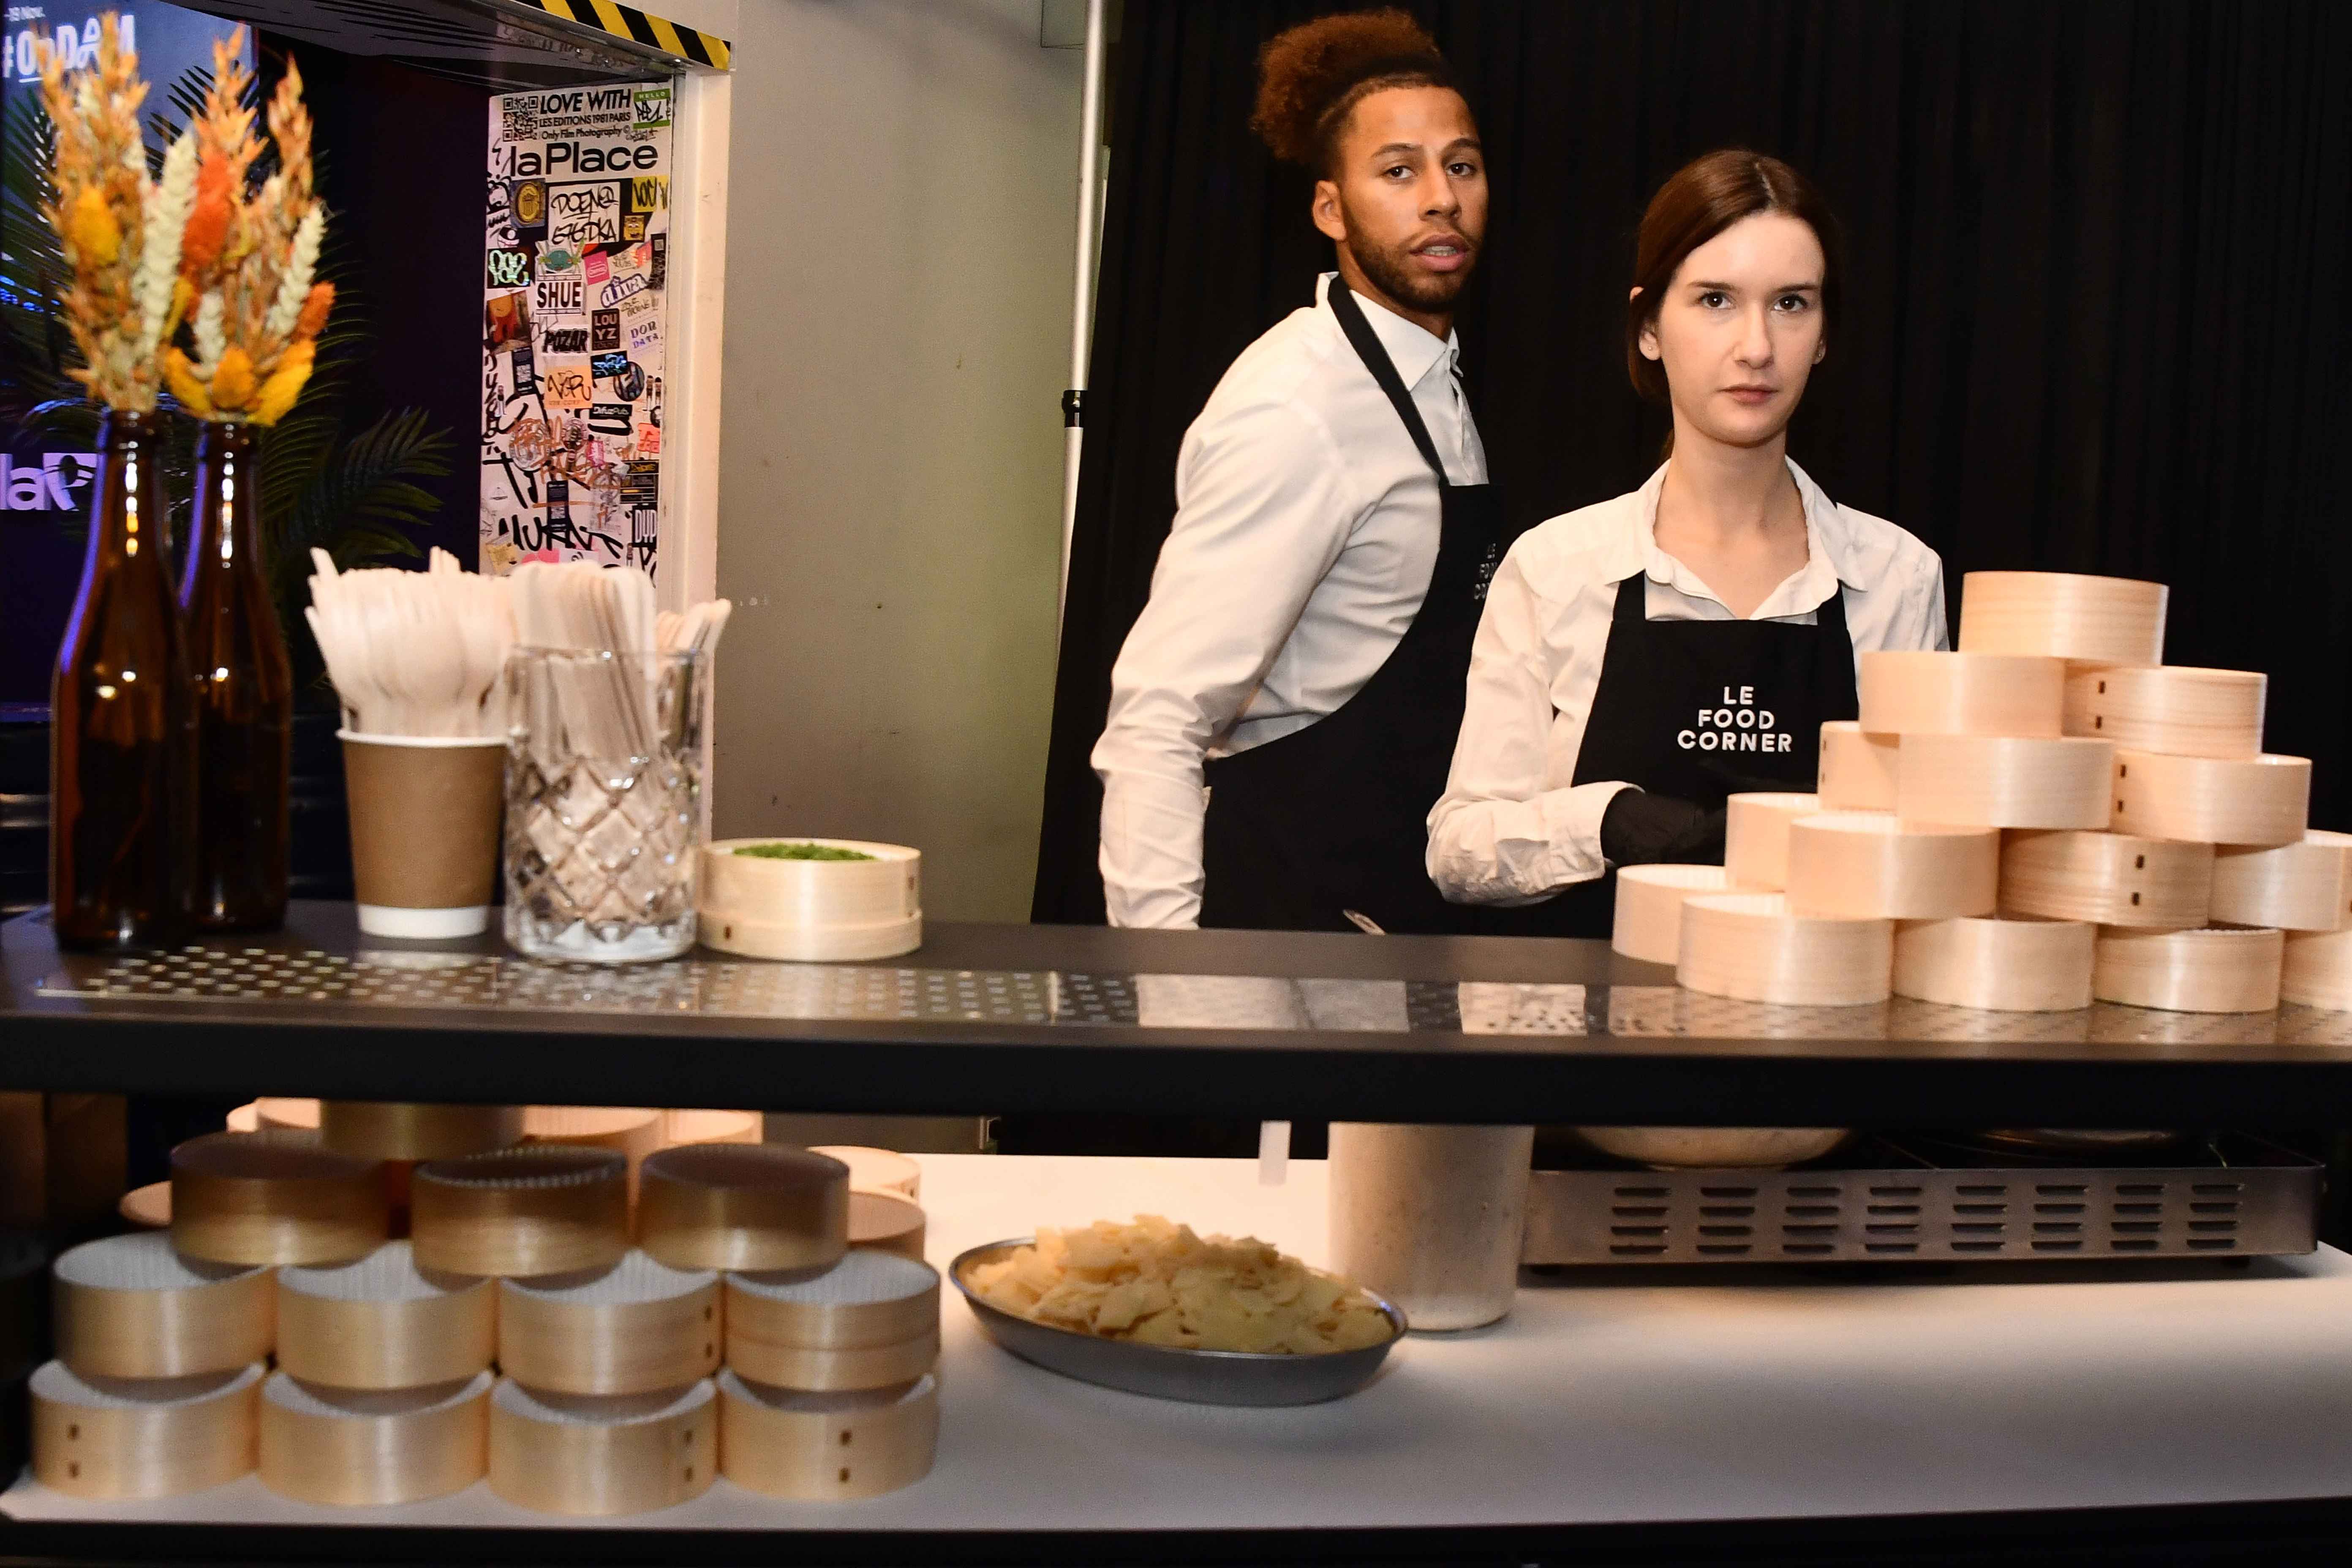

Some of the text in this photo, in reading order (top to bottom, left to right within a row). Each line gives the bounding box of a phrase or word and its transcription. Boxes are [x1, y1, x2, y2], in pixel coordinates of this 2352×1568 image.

[540, 93, 583, 114] LOVE
[587, 89, 631, 112] WITH
[539, 112, 631, 127] LES EDITIONS 1981 PARIS
[542, 130, 559, 141] Only
[561, 128, 574, 138] Film
[576, 125, 622, 138] Photography
[536, 281, 582, 308] SHUE
[594, 314, 617, 326] LOU
[596, 328, 617, 340] YZ
[1723, 686, 1754, 705] LE
[1698, 709, 1775, 730] FOOD
[1677, 730, 1792, 753] CORNER
